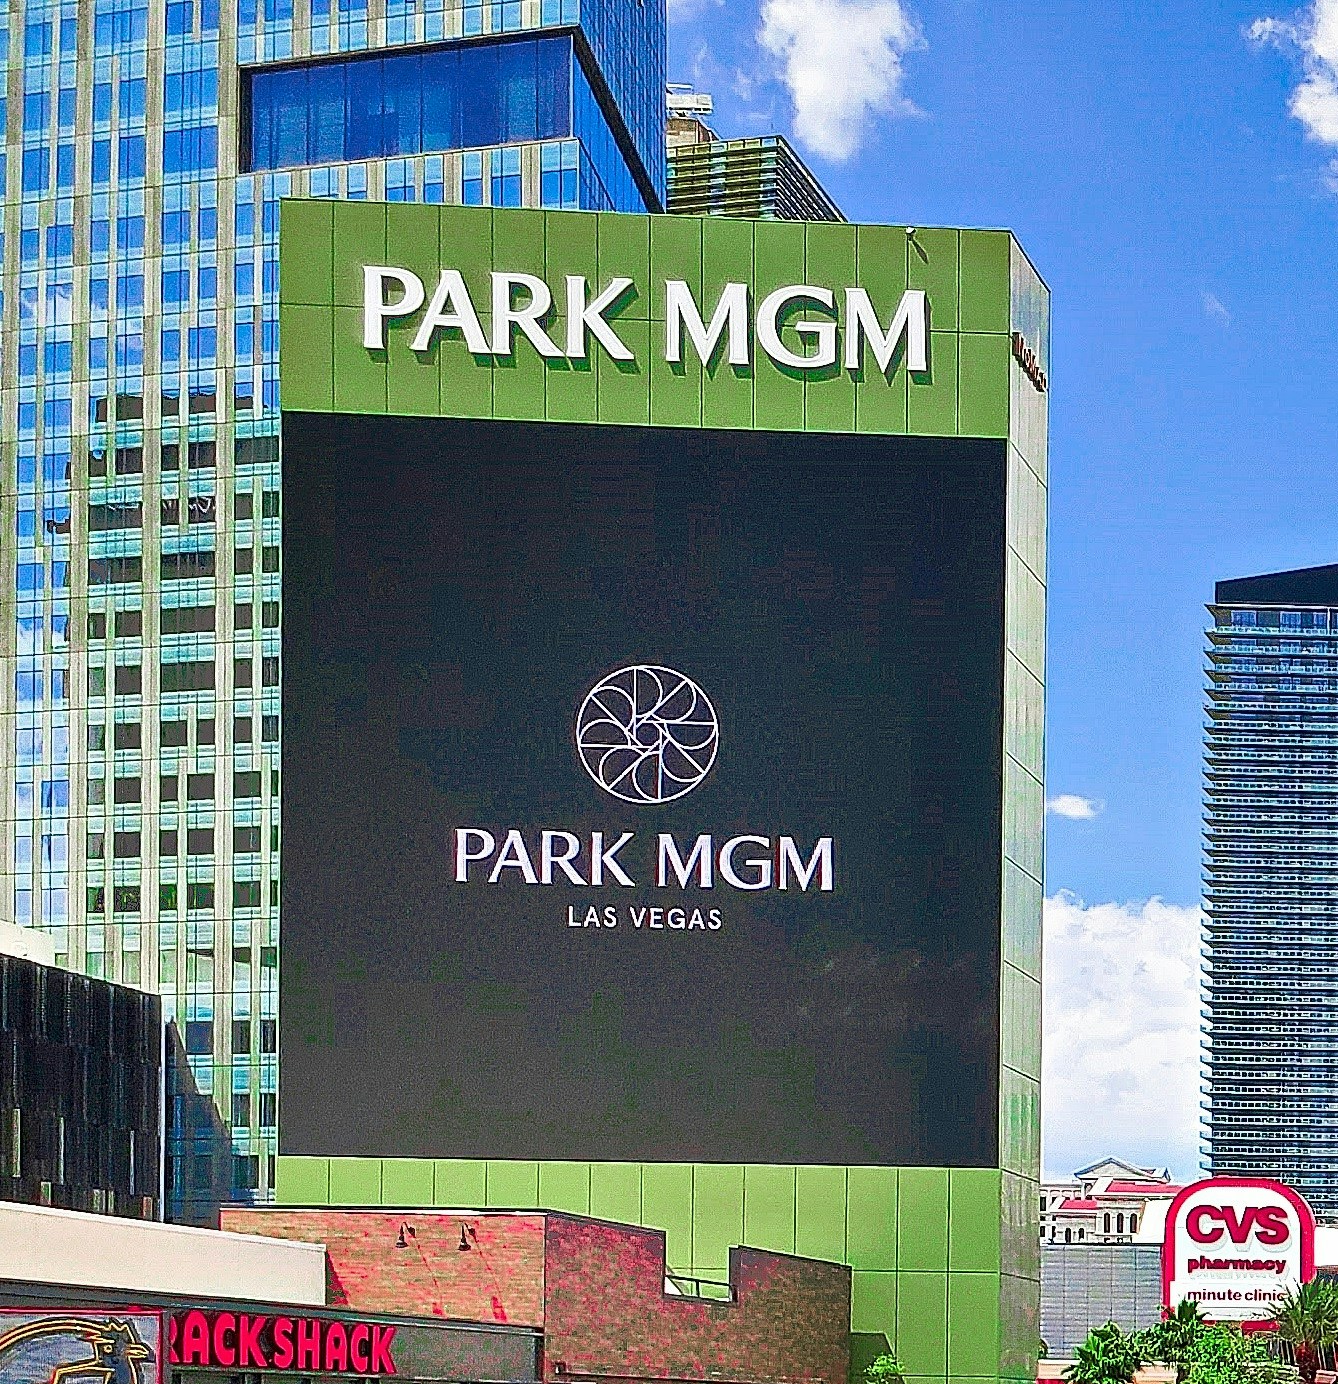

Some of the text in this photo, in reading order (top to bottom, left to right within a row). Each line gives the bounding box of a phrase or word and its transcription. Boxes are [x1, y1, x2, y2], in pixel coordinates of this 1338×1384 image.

[362, 265, 636, 362] PARK
[665, 279, 930, 375] MGM
[454, 828, 834, 891] PARK MGM
[567, 905, 723, 931] LAS VEGAS
[1186, 1205, 1290, 1245] CVS
[1187, 1255, 1287, 1275] pharmacy
[1187, 1288, 1242, 1301] minute
[274, 1316, 397, 1374] SHACK
